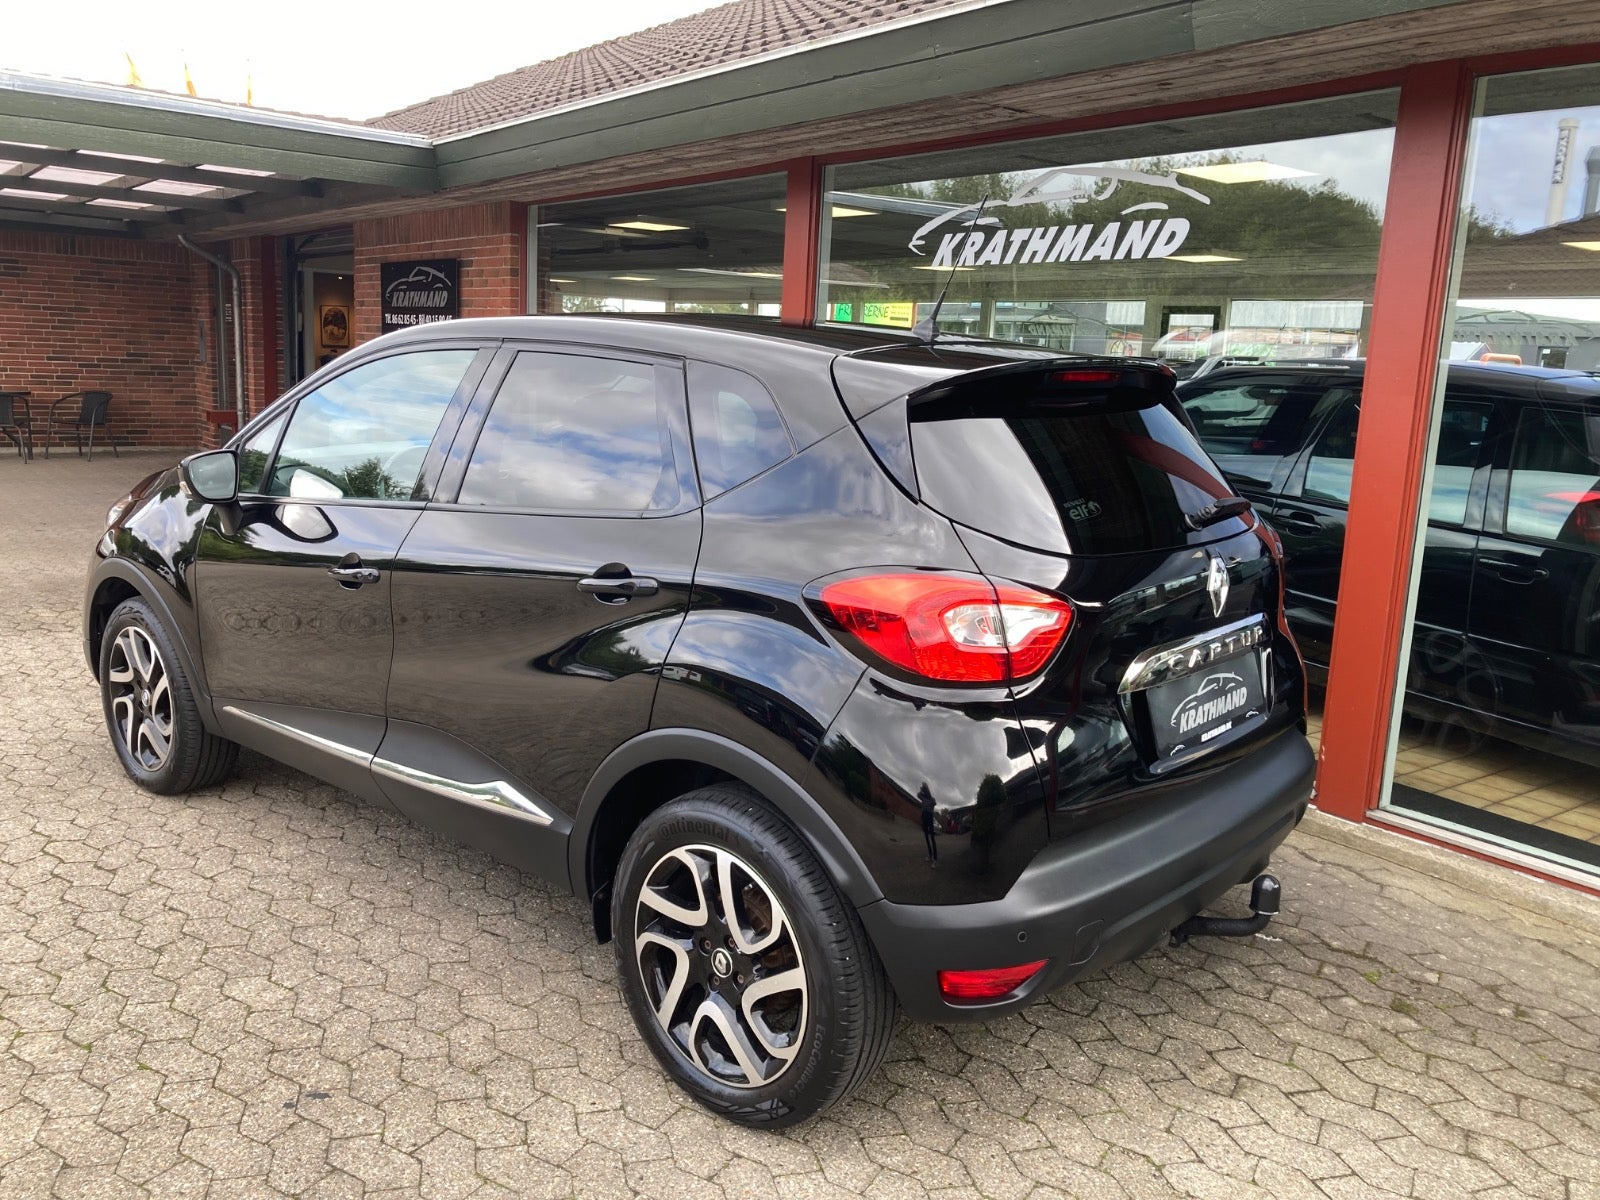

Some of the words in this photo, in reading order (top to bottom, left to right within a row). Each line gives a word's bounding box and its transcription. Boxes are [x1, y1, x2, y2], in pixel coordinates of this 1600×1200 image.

[932, 217, 1190, 267] KRATHMAND
[391, 290, 448, 307] KRATHMAND
[1069, 504, 1089, 520] elf
[1167, 625, 1264, 671] CAPTUR
[1179, 686, 1248, 734] KRATHMAND
